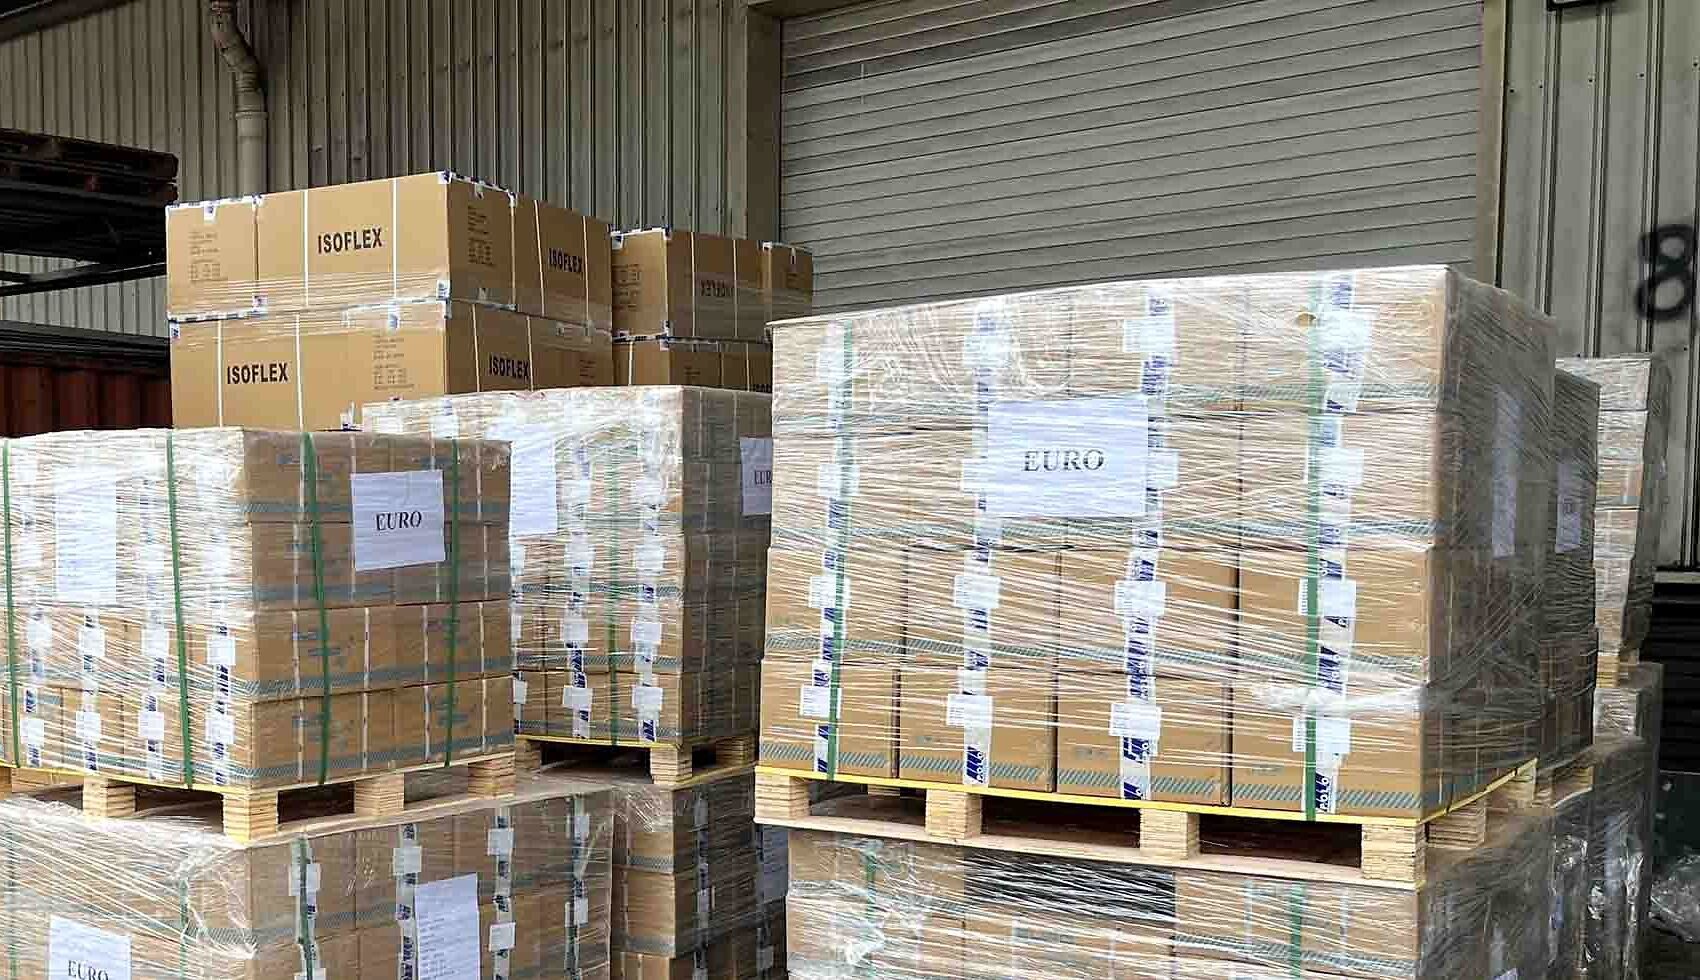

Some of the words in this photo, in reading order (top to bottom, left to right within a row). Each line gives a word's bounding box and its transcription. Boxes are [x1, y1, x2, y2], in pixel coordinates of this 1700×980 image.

[318, 228, 383, 253] ISOFLEX
[548, 249, 585, 275] ISOFLEX
[1635, 224, 1698, 320] 8
[227, 358, 289, 385] ISOFLEX
[488, 355, 531, 381] ISOFLEX
[1024, 449, 1105, 472] EURO
[755, 469, 772, 484] EUR
[375, 511, 421, 531] EURO
[68, 959, 109, 980] EURO
